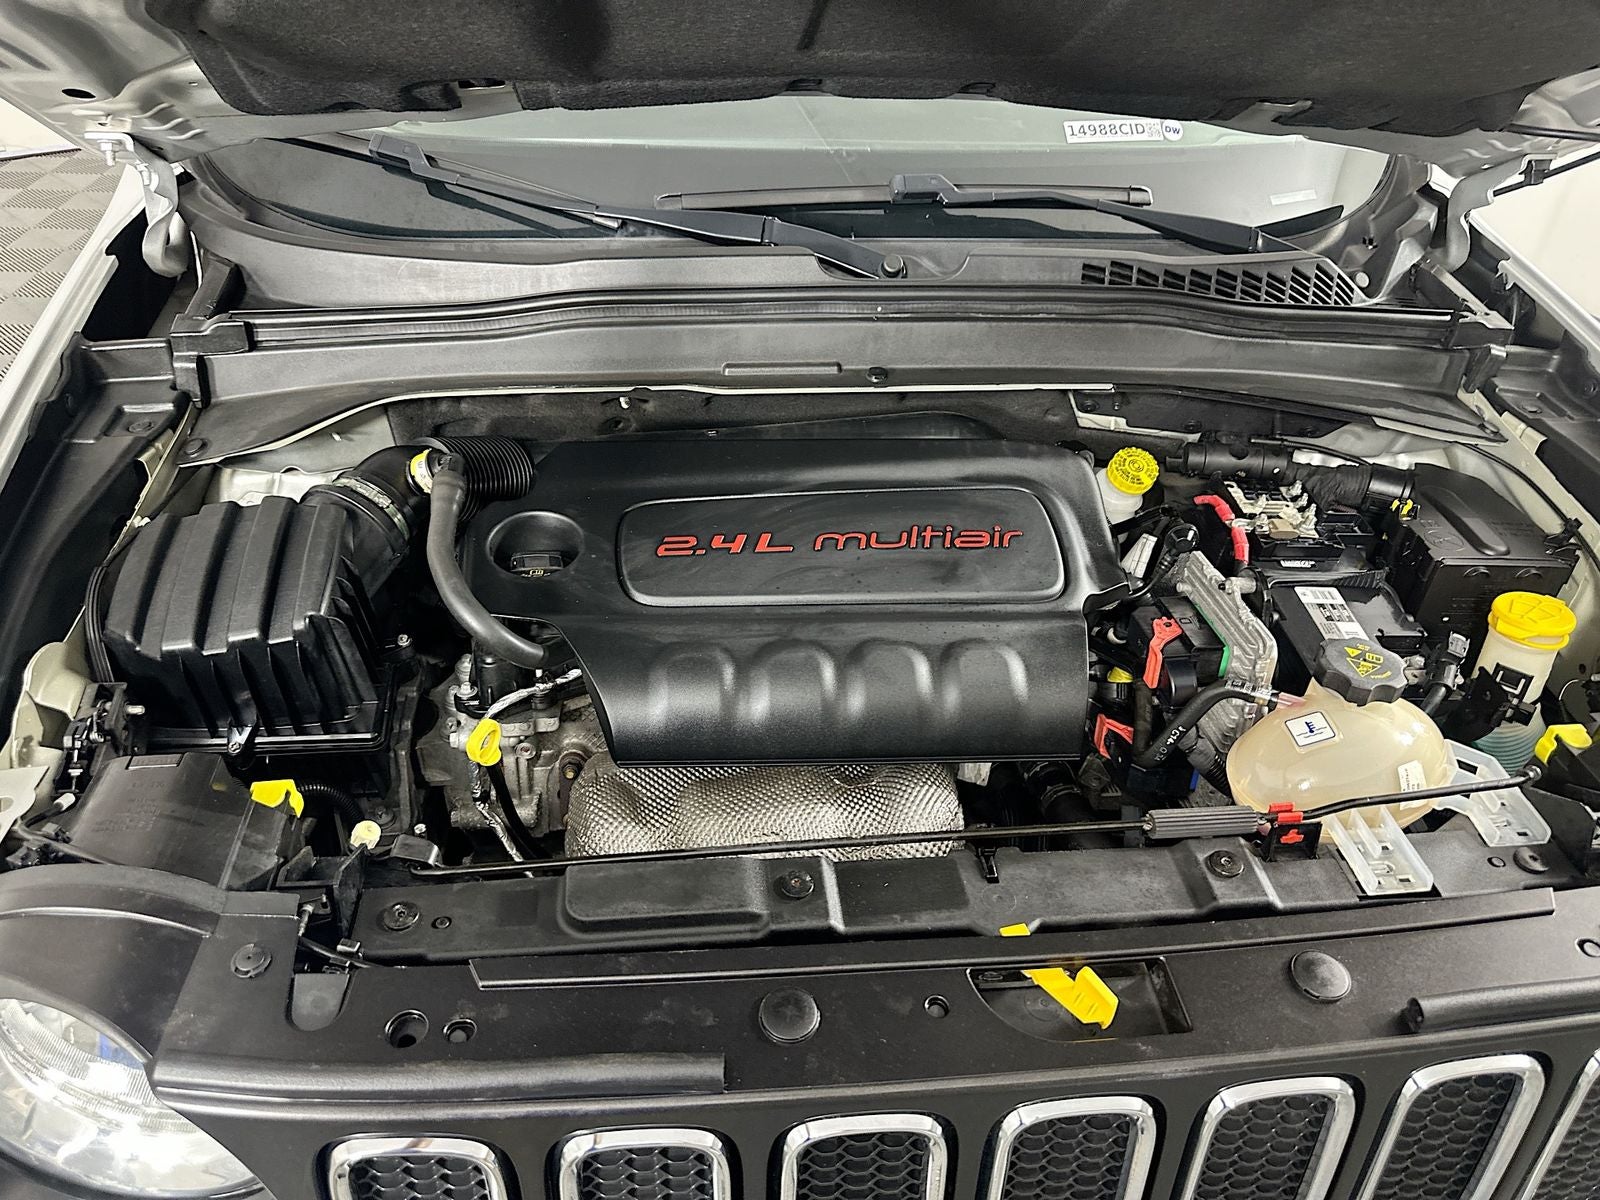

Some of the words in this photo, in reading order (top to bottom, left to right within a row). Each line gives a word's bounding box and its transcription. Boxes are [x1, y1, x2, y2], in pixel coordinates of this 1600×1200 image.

[1067, 122, 1146, 137] 14988CID
[1164, 125, 1181, 135] DW
[813, 524, 1024, 551] multiair
